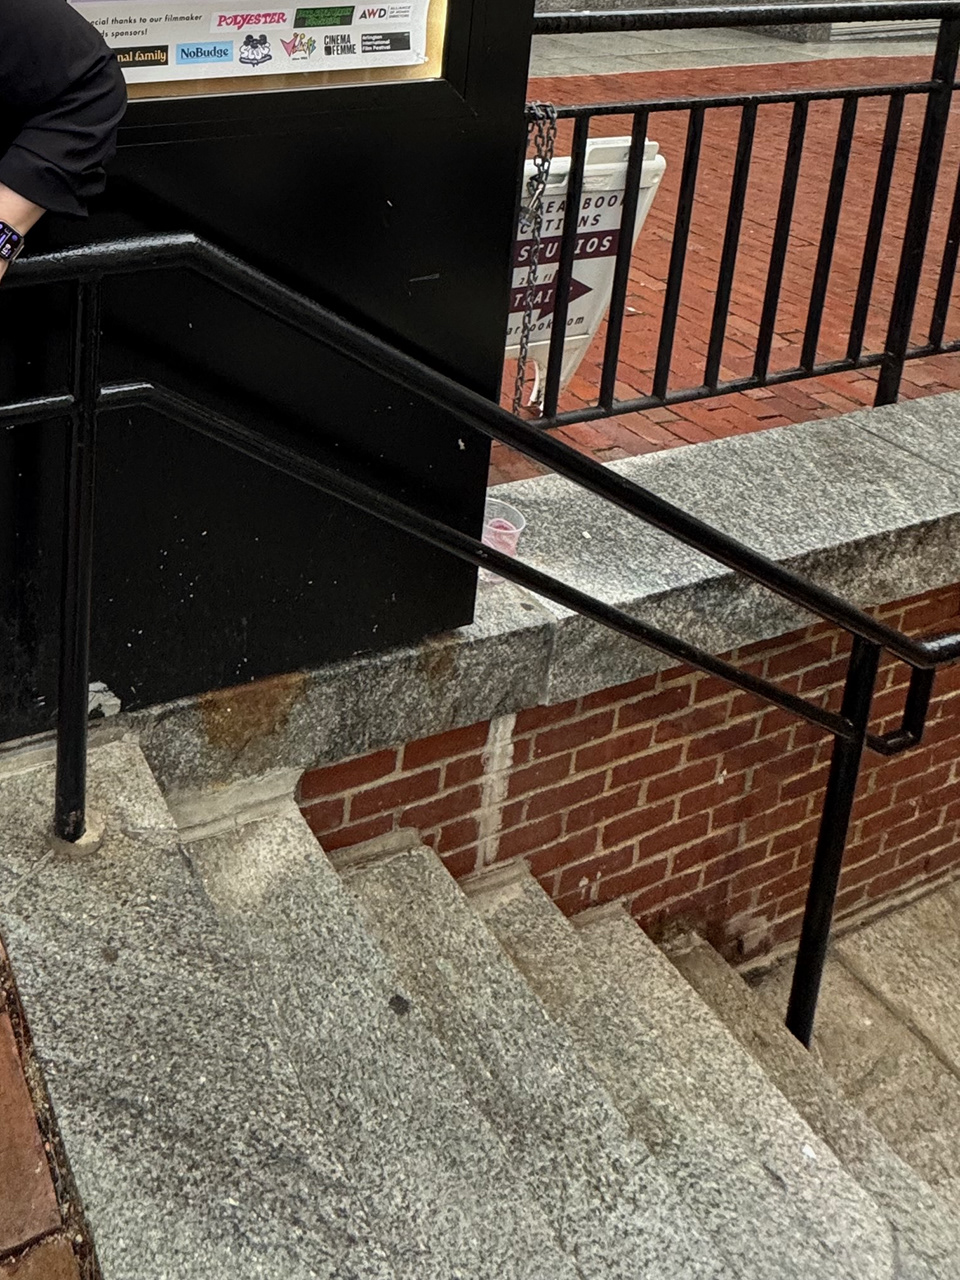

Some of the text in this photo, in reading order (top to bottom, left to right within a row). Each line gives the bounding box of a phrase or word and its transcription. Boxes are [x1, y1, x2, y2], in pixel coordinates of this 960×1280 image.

[111, 16, 137, 25] thanks
[149, 16, 162, 24] our
[164, 13, 203, 23] filmmaker
[359, 7, 387, 20] AWD
[217, 11, 287, 31] POLYESTER
[111, 28, 148, 39] sponsors!
[324, 34, 351, 46] CINEMA
[135, 49, 167, 63] family
[180, 45, 229, 60] NoBudge
[331, 43, 357, 56] FEMME
